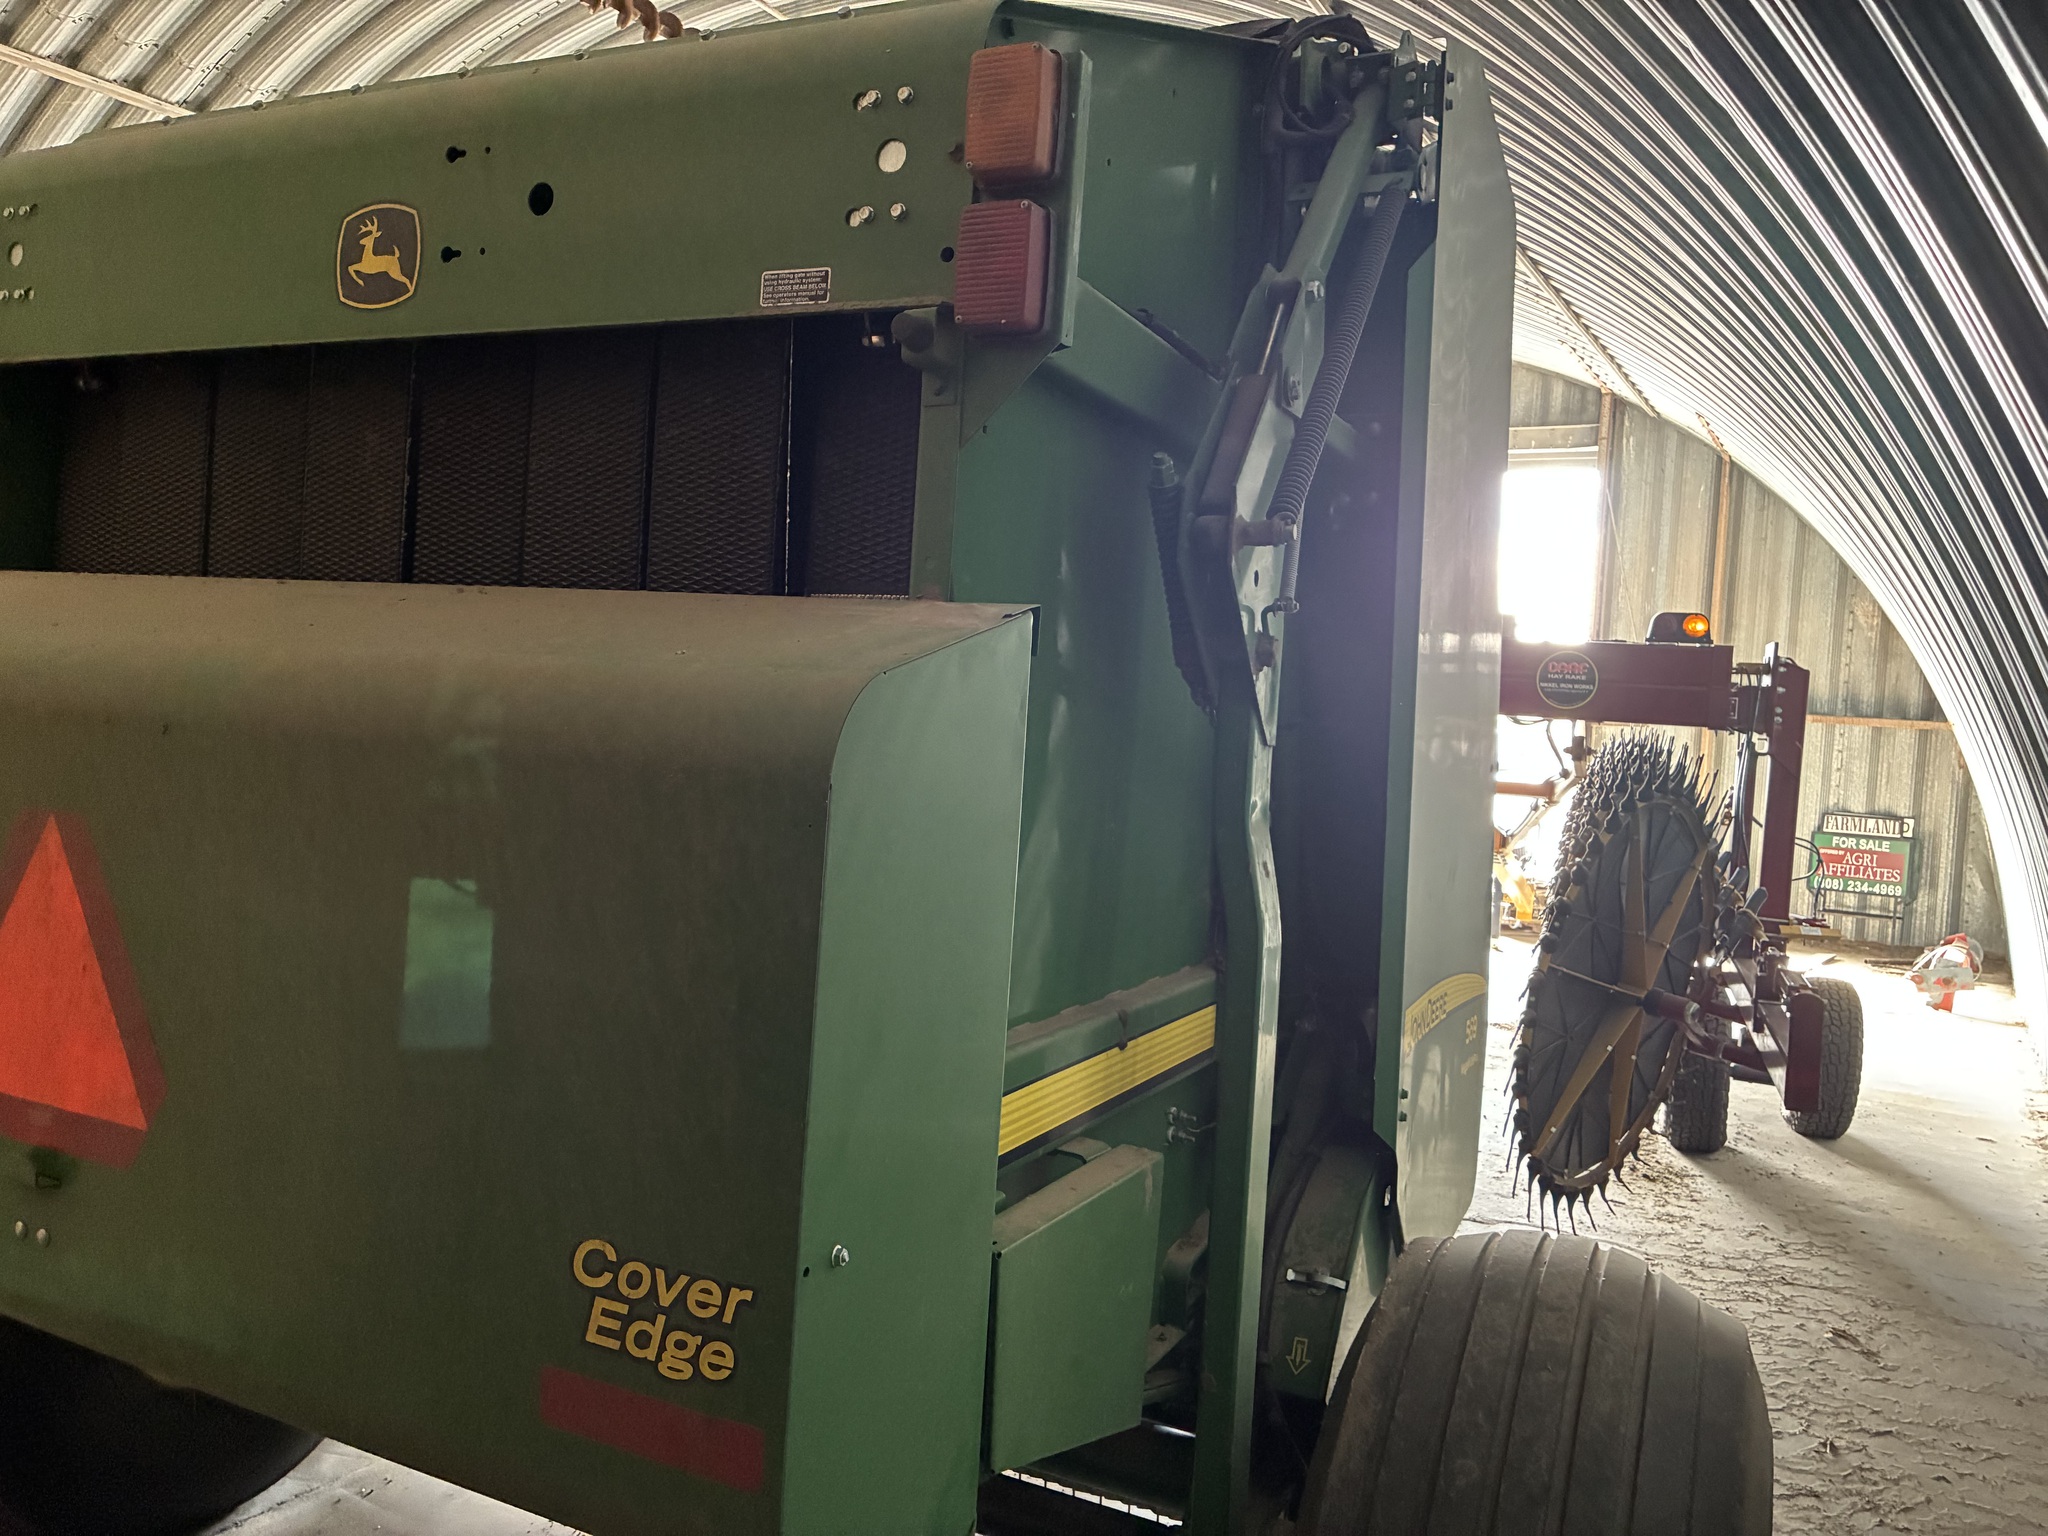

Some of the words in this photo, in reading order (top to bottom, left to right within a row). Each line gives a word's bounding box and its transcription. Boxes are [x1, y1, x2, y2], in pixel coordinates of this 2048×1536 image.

[1832, 836, 1857, 849] FOR
[1859, 839, 1890, 852] SALE
[1843, 852, 1878, 867] AGRI
[1818, 862, 1901, 882] AFFILIATES
[1847, 880, 1902, 896] 234-4969
[572, 1238, 754, 1325] Cover
[585, 1296, 736, 1382] Edge
